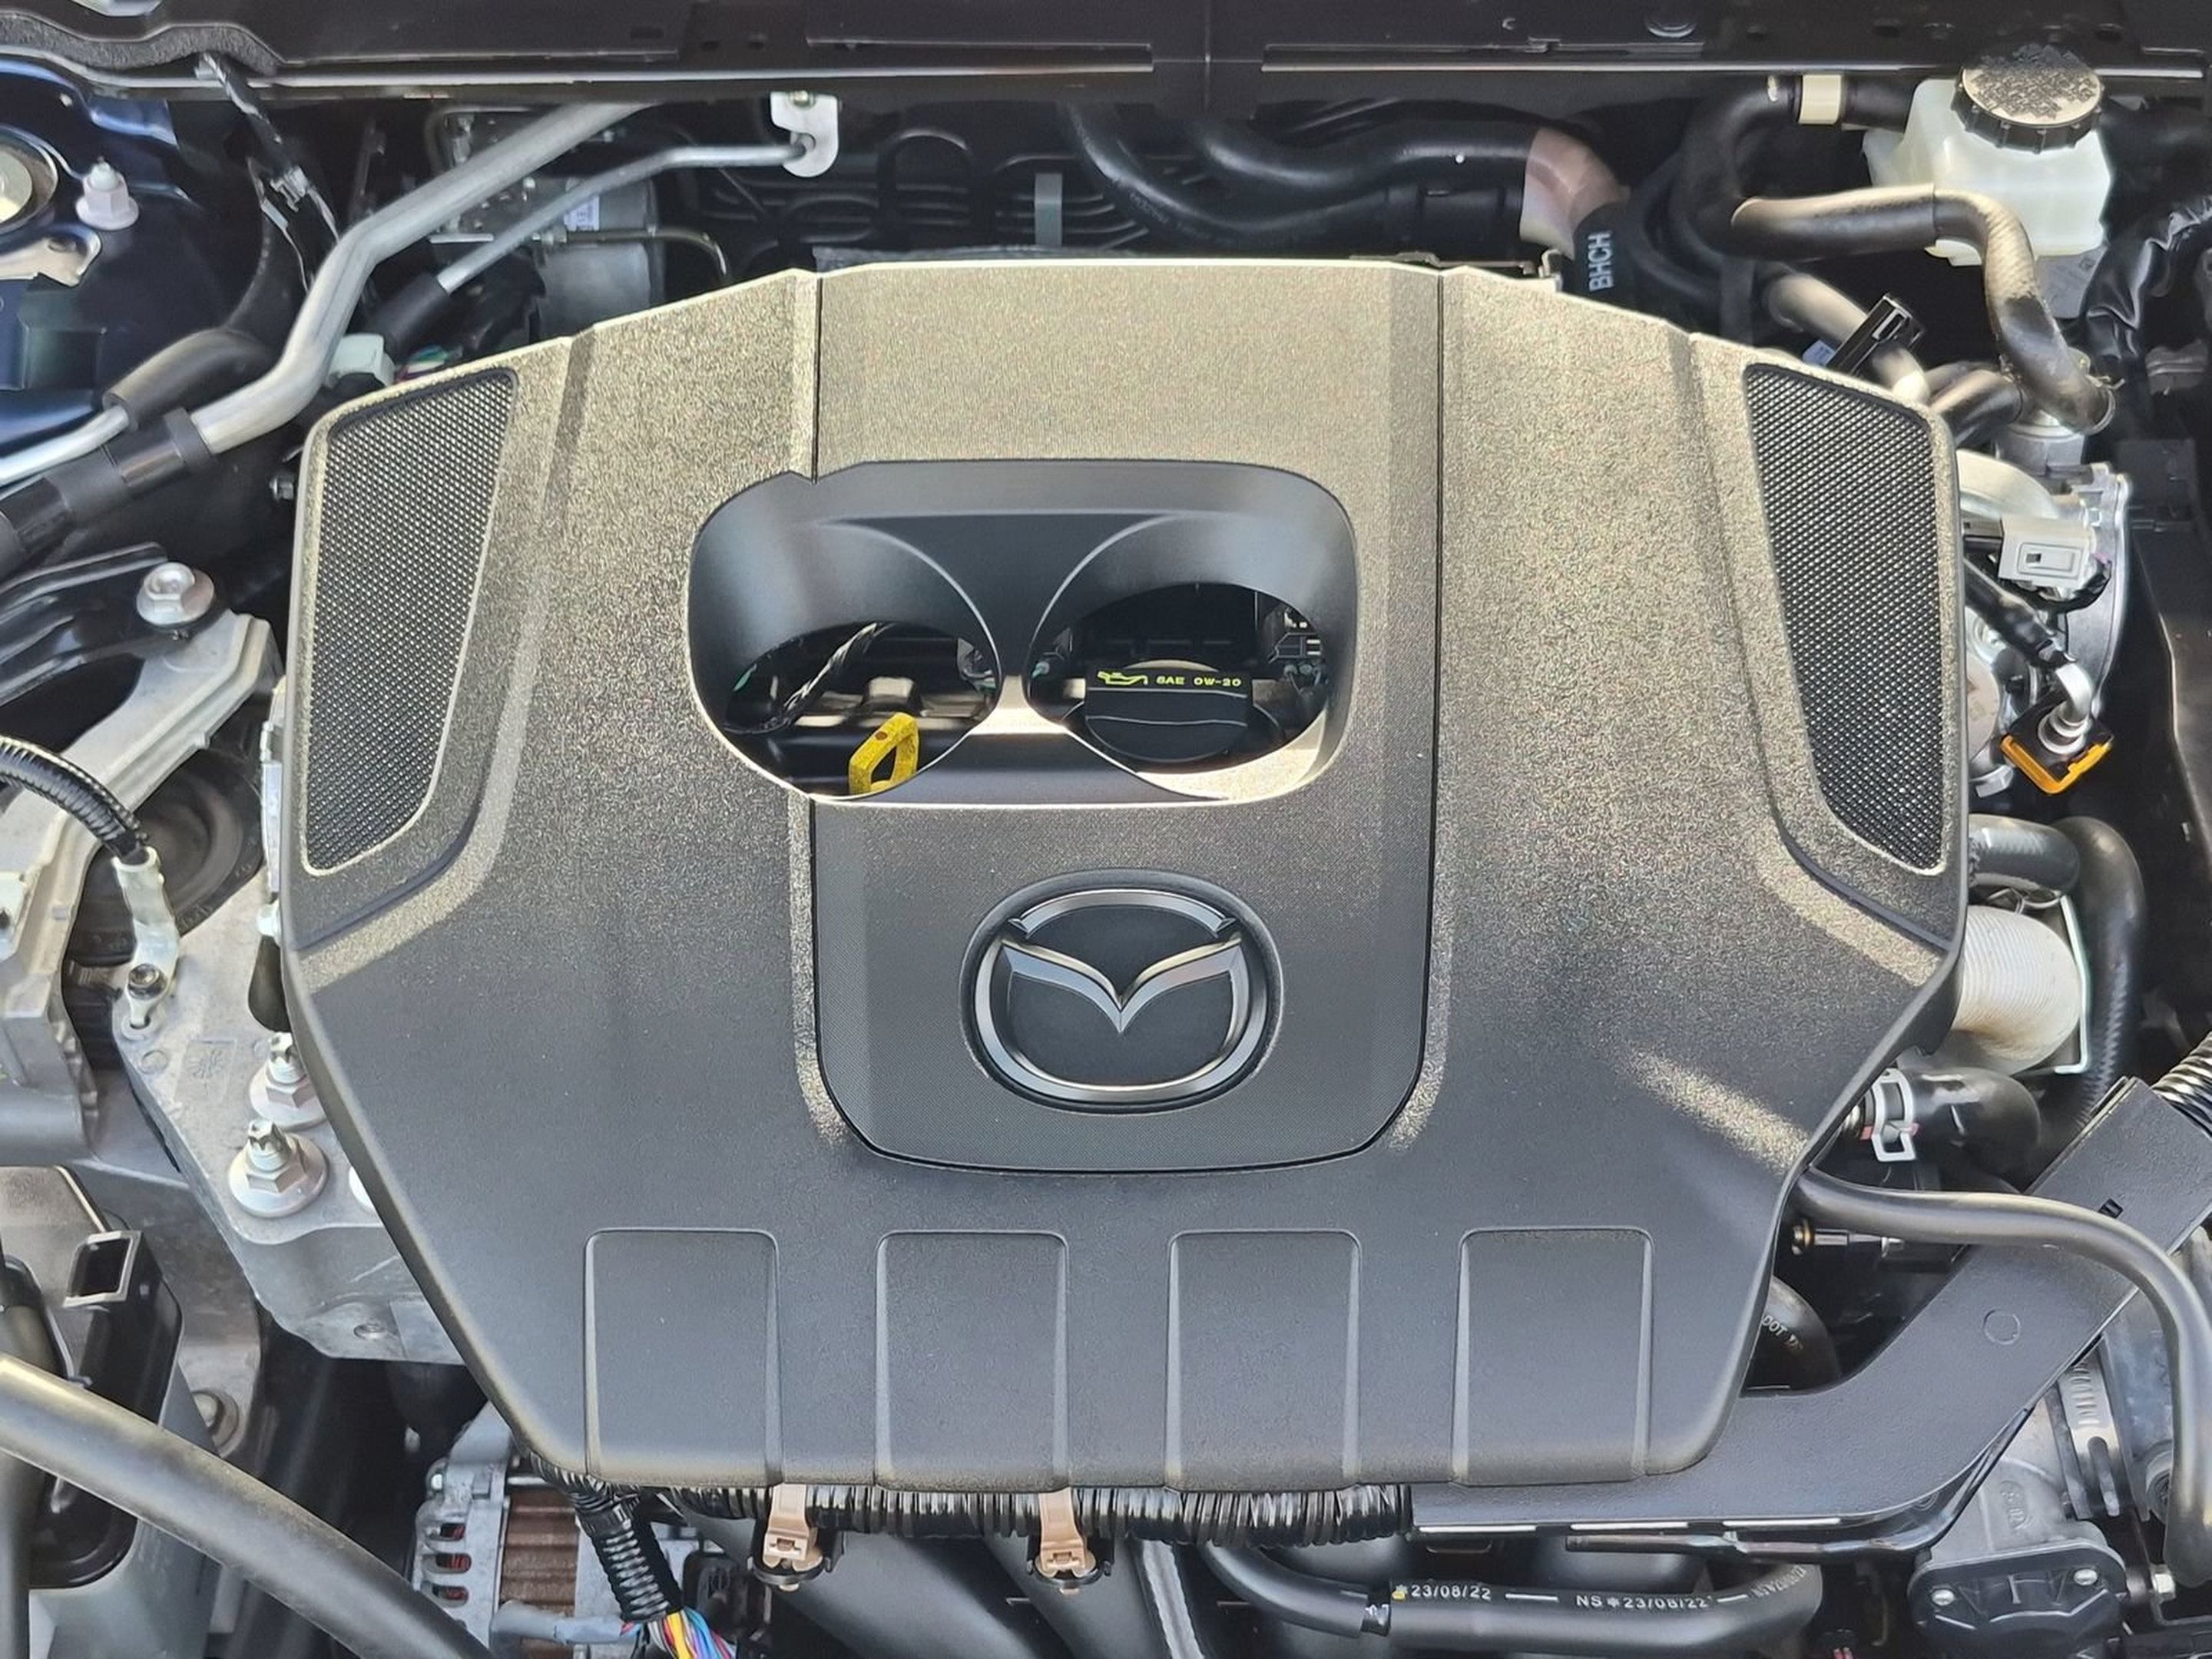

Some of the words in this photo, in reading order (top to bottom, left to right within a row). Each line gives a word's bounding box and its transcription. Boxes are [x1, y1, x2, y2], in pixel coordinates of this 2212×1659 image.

[1588, 233, 1614, 291] BHCH
[1194, 677, 1242, 687] 0W-20
[1410, 1584, 1492, 1601] 23/08/22
[1576, 1595, 1602, 1608] NS
